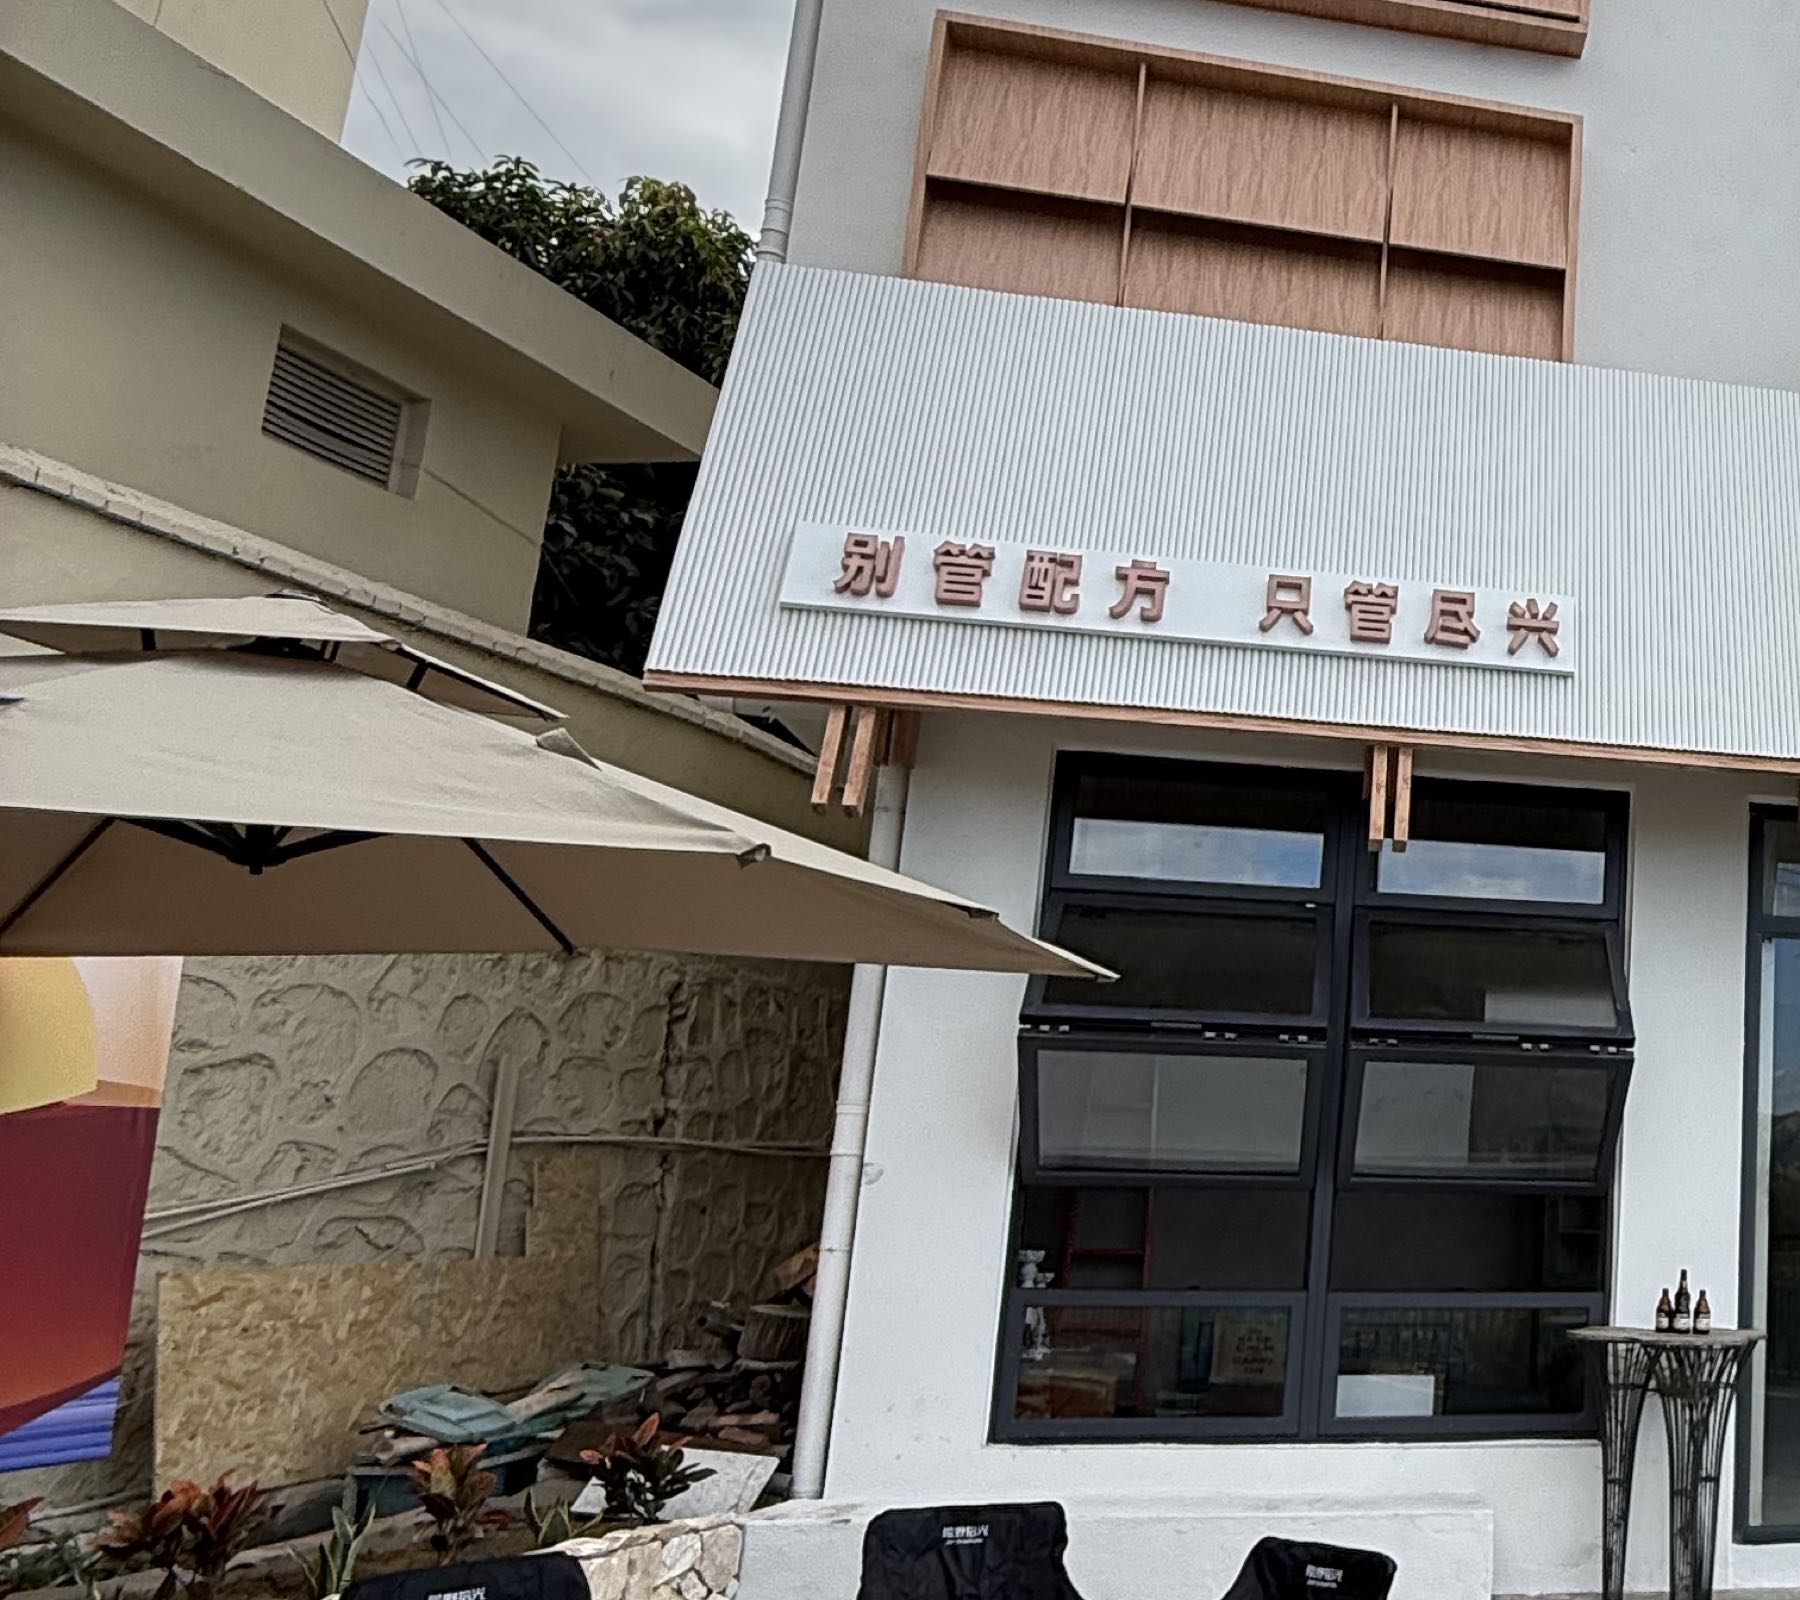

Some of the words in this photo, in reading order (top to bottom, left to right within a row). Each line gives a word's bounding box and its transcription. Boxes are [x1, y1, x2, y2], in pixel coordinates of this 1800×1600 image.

[833, 532, 1171, 623] 别管配方
[1258, 573, 1561, 658] 只管尽兴
